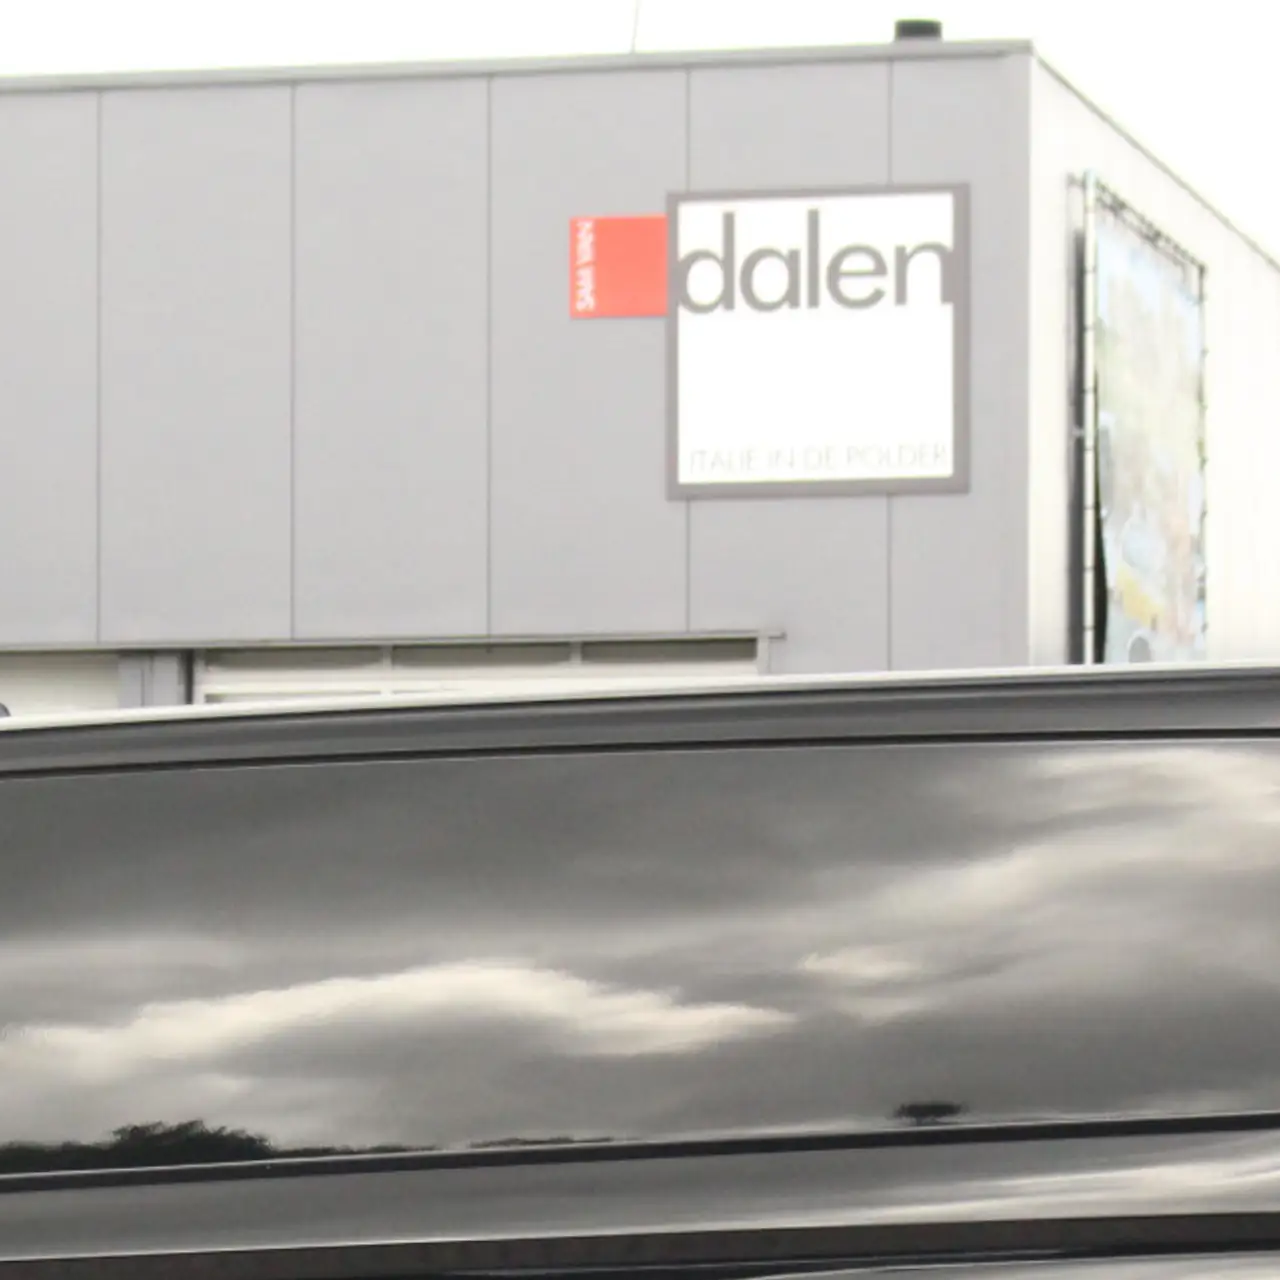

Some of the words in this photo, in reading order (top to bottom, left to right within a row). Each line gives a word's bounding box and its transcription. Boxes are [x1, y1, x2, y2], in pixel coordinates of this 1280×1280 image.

[672, 208, 954, 315] dalen
[804, 444, 837, 471] DE
[846, 441, 947, 468] POLDER
